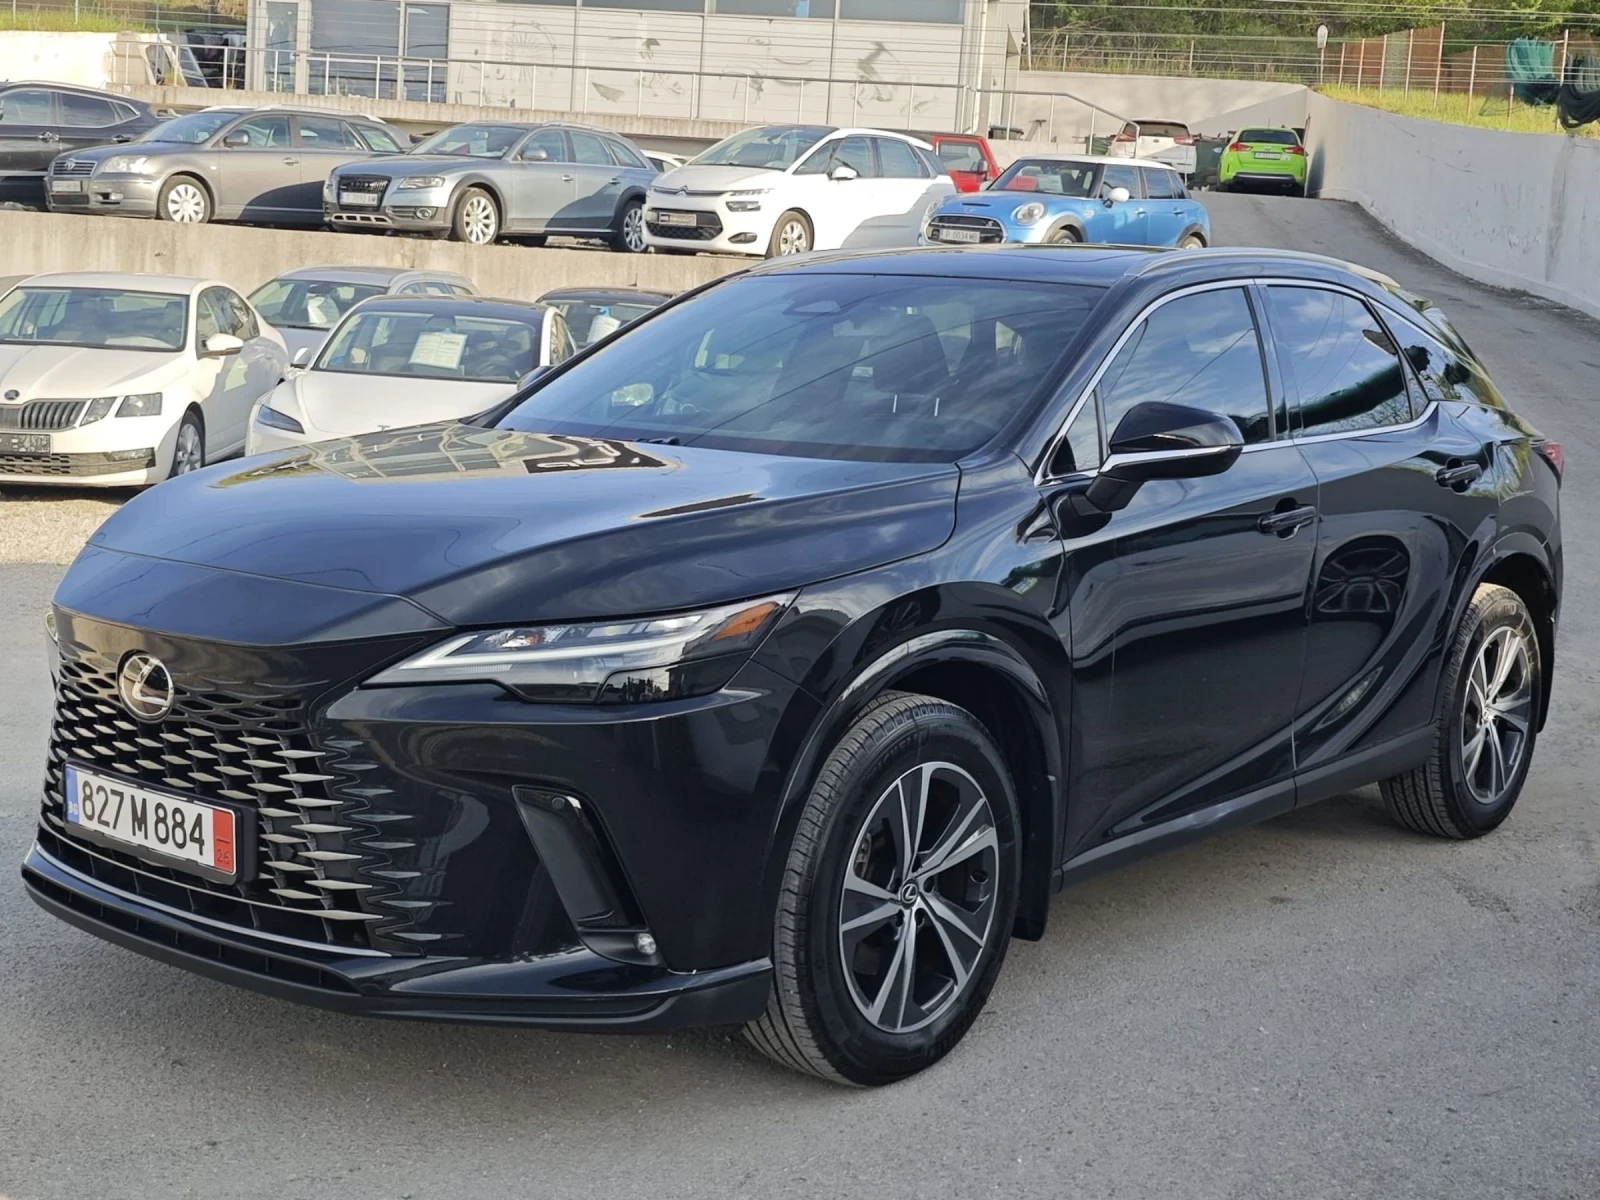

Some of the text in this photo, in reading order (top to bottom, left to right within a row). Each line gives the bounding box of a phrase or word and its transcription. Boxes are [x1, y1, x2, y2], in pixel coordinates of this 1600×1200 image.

[68, 801, 79, 815] BG
[82, 780, 205, 856] 827 M 884
[216, 849, 230, 865] 26
